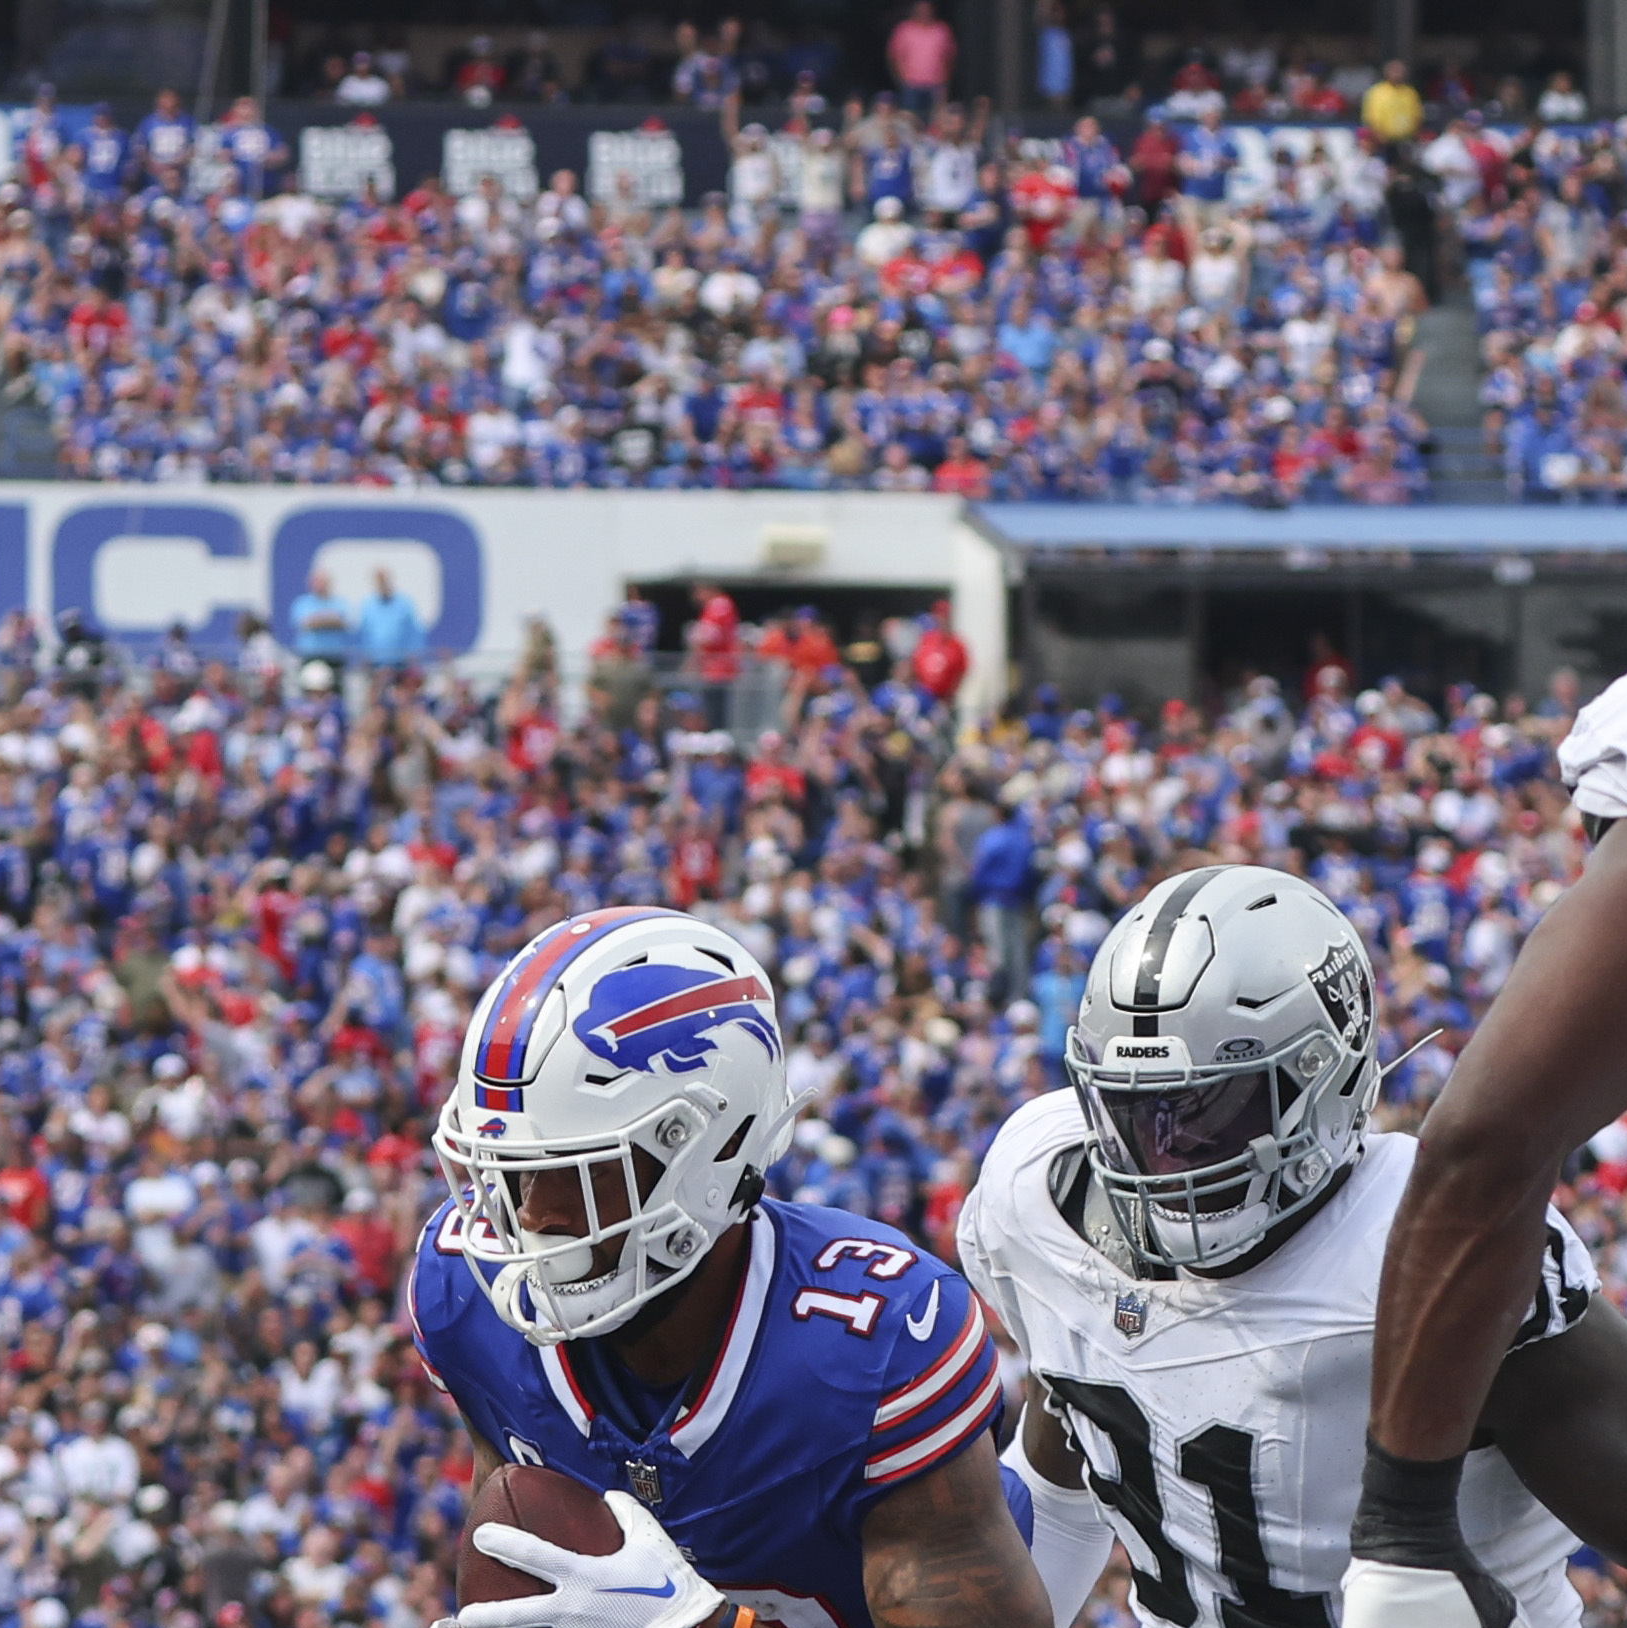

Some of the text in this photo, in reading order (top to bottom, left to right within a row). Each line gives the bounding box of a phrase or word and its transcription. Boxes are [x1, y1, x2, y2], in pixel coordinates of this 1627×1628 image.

[1116, 1045, 1170, 1059] RAIDERS
[1215, 1048, 1265, 1062] OAKLEY
[791, 1236, 921, 1338] 13
